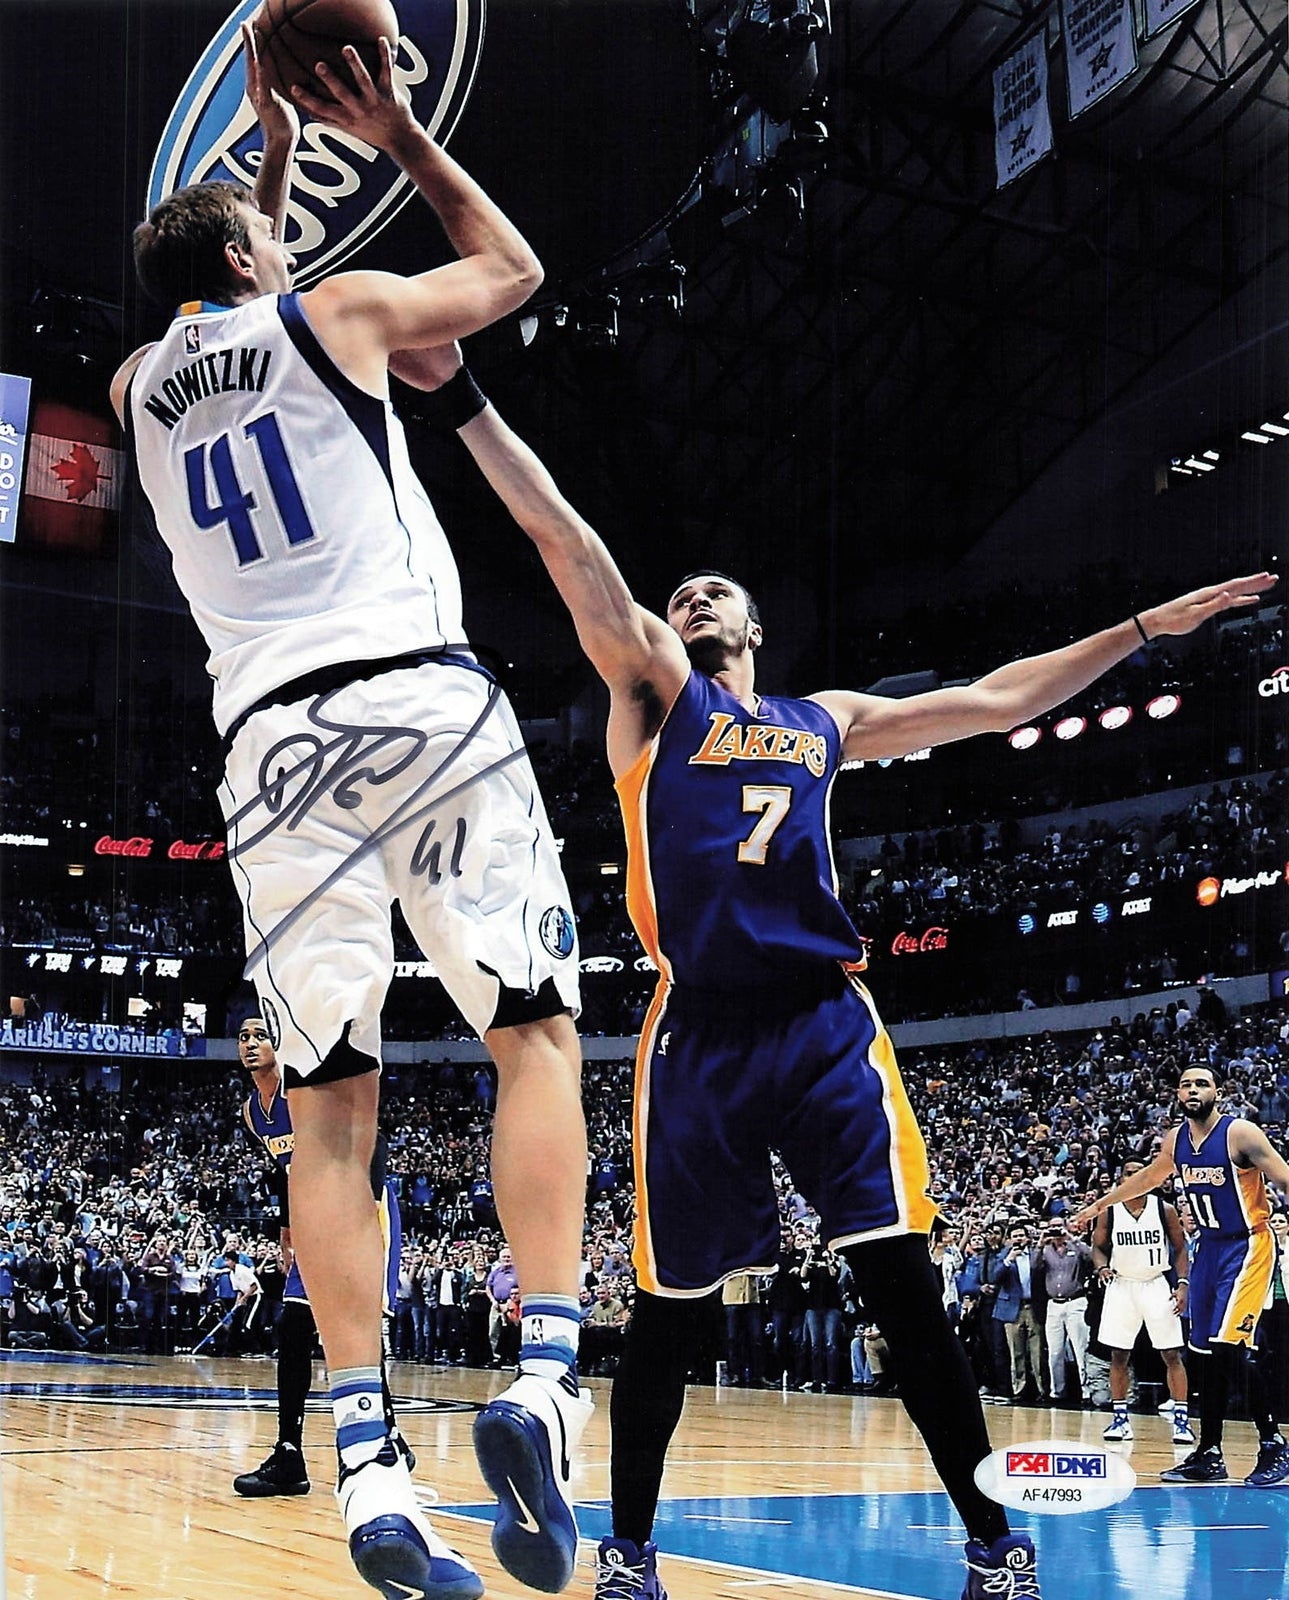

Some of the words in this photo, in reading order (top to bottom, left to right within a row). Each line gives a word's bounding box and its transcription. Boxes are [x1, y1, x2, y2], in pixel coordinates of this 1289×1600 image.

[144, 348, 272, 431] NOWITZKI
[181, 406, 324, 573] 41
[688, 712, 827, 777] LAKERS
[737, 785, 792, 865] 7
[410, 817, 467, 885] 41
[1047, 910, 1078, 928] AT&T
[0, 1027, 89, 1050] ARLISLE'S
[92, 1031, 168, 1054] CORNER
[1181, 1163, 1225, 1187] LAKERS
[1189, 1193, 1220, 1229] 11
[1116, 1229, 1161, 1246] DALLAS
[1148, 1248, 1161, 1267] 11
